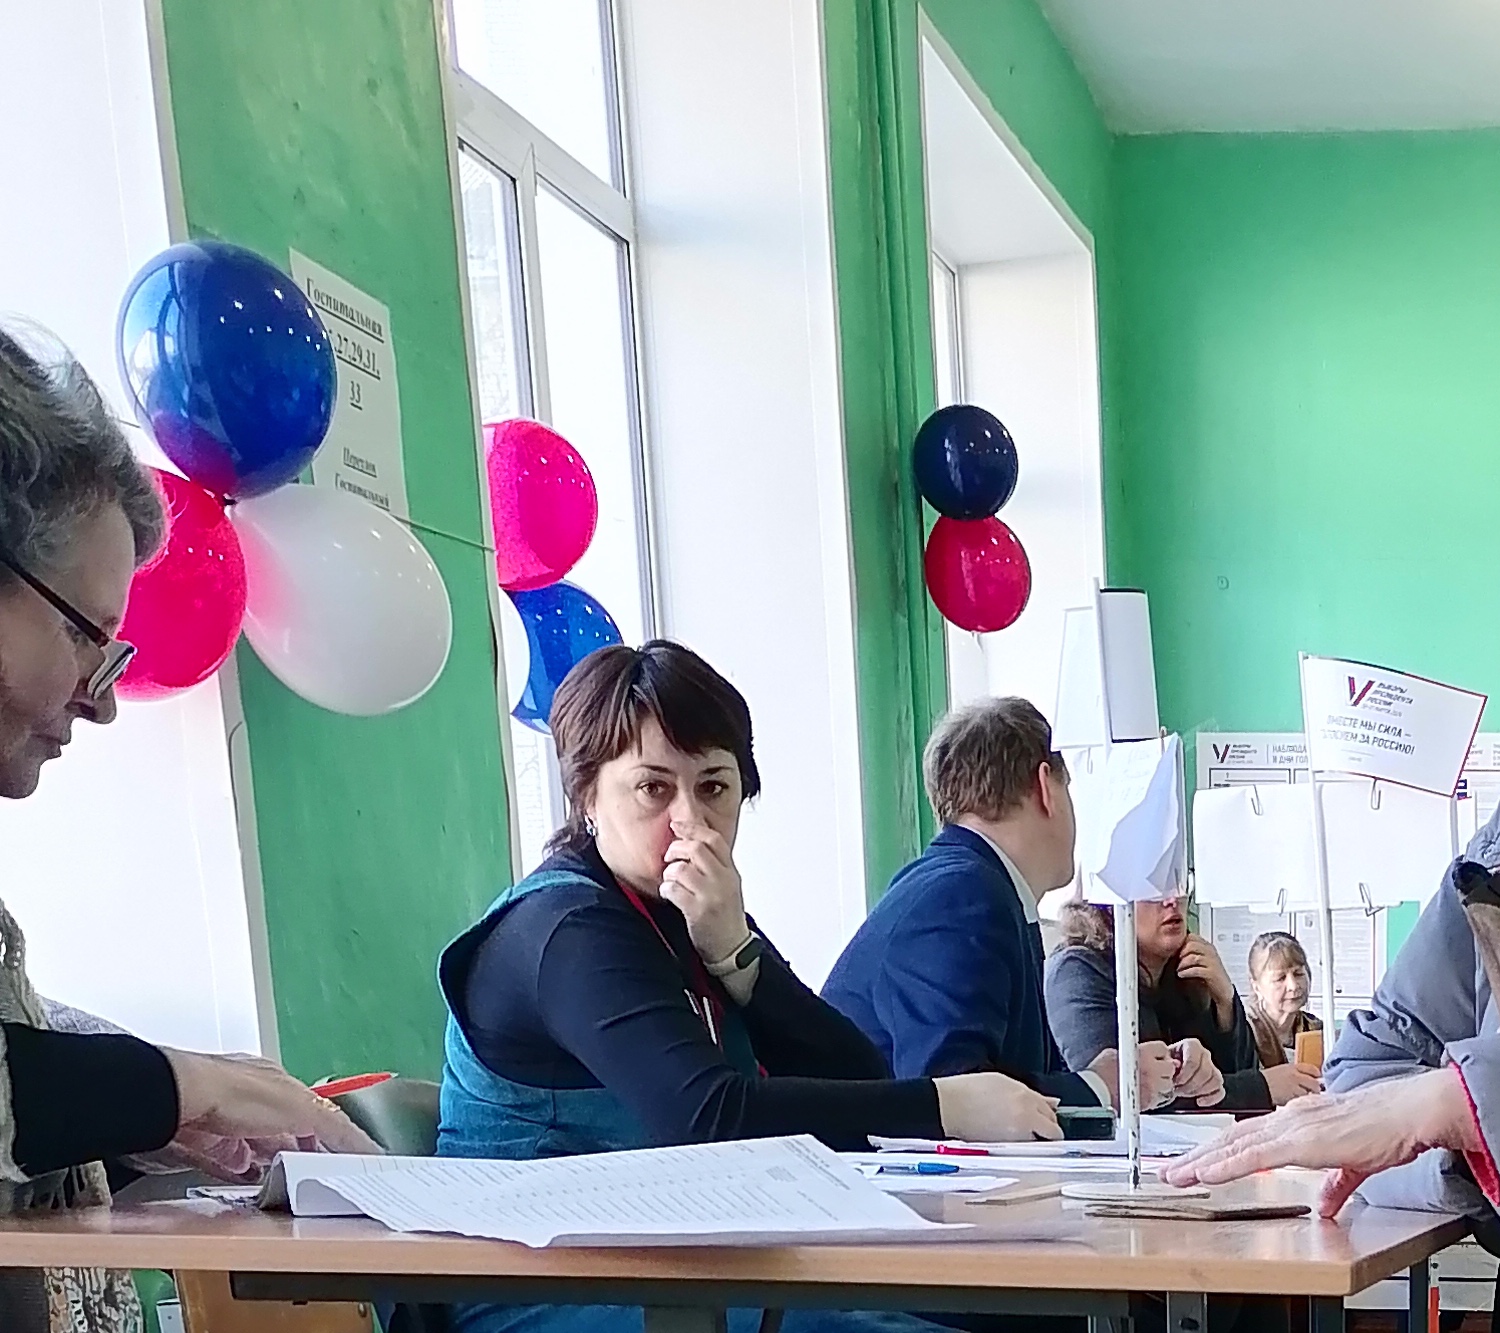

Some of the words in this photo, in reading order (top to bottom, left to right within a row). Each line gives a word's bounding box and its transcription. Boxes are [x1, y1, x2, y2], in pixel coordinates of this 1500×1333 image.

[307, 277, 383, 337] Госпитальная
[349, 380, 362, 404] 33
[1360, 720, 1376, 731] МЫ
[1377, 723, 1402, 738] СИЛА
[1359, 733, 1370, 745] ЗА
[1371, 736, 1415, 756] РОССИЮ!
